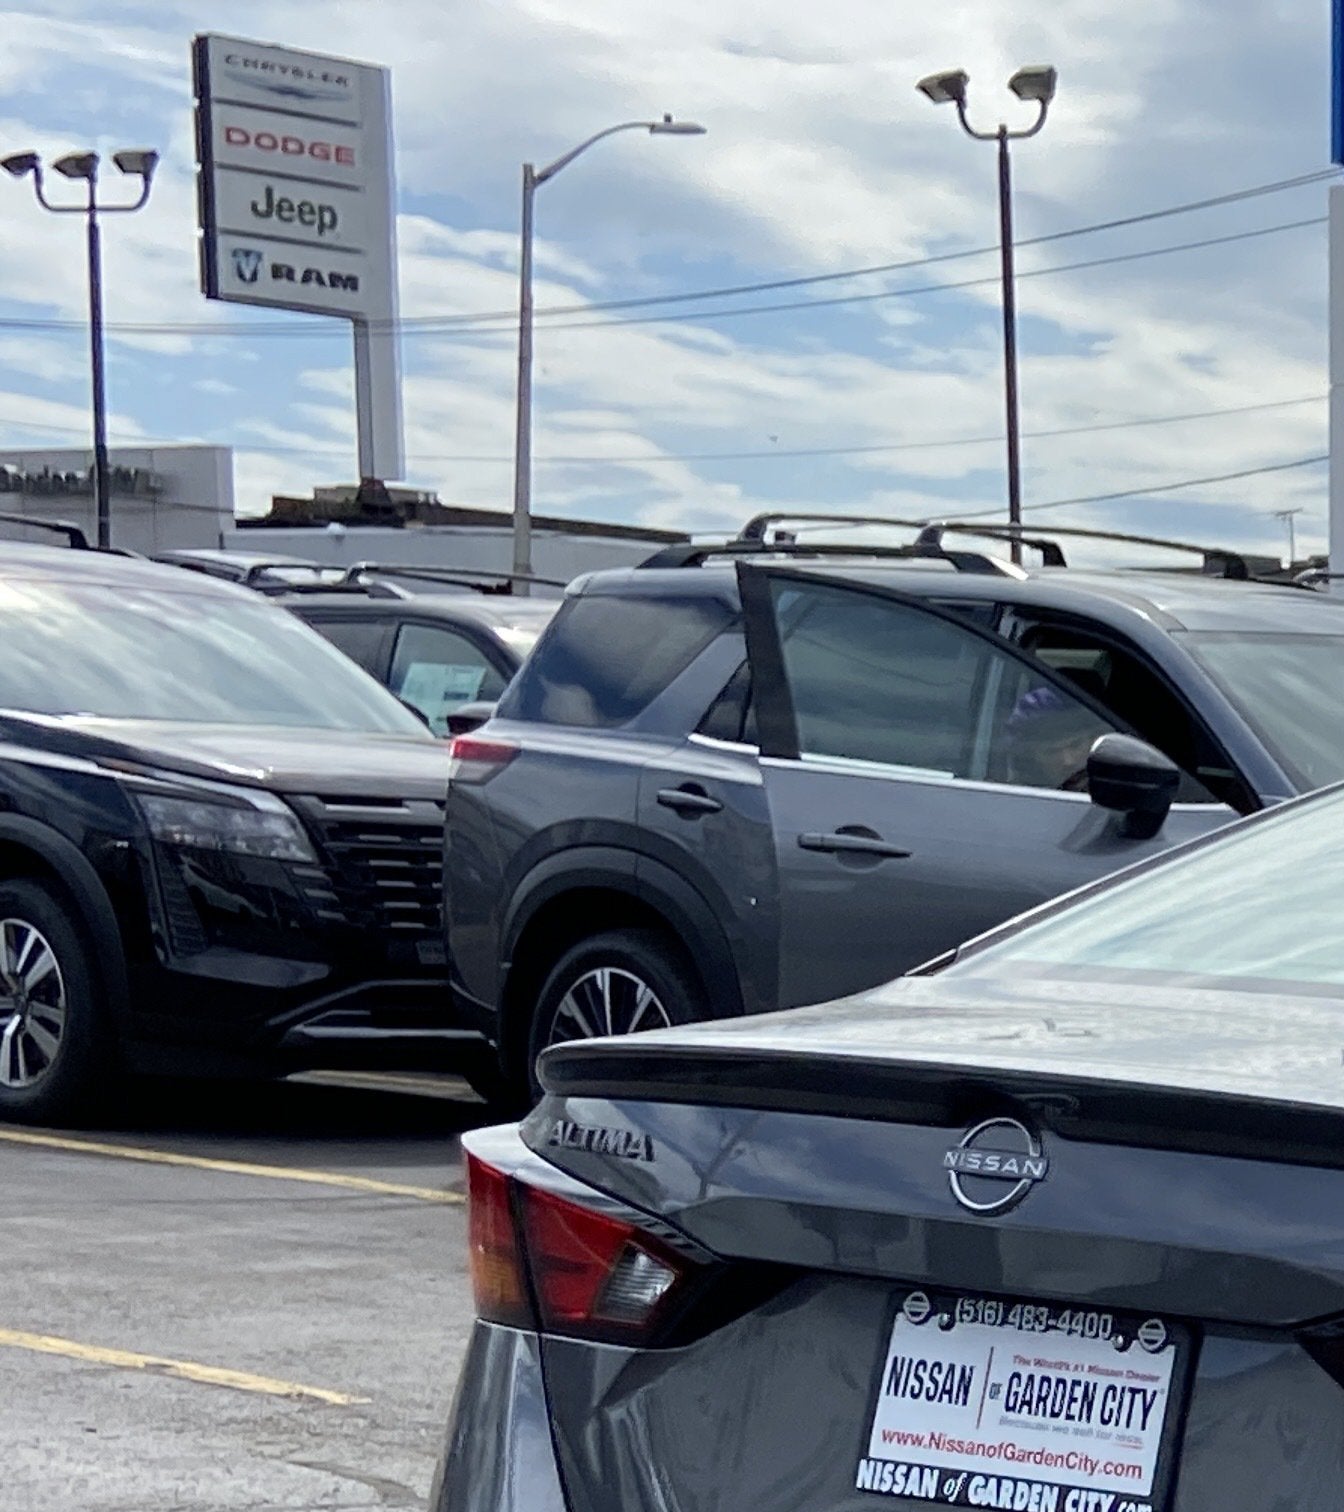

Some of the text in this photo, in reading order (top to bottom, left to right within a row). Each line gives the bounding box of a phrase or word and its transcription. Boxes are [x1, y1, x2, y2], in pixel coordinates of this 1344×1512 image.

[224, 54, 350, 88] CHRYSLER
[224, 126, 357, 166] DODGE
[251, 184, 339, 237] Jeep
[271, 263, 360, 293] RAM
[549, 1119, 656, 1162] ALTIMA
[943, 1151, 1043, 1176] NISSAN
[954, 1297, 1113, 1340] (516) 483-4400
[886, 1355, 974, 1407] NISSAN
[1004, 1371, 1098, 1424] GARDEN
[1099, 1384, 1157, 1432] CITY
[881, 1428, 1143, 1480] www.NissanofGardenCity.com
[856, 1458, 939, 1499] NISSAN
[942, 1471, 968, 1502] of
